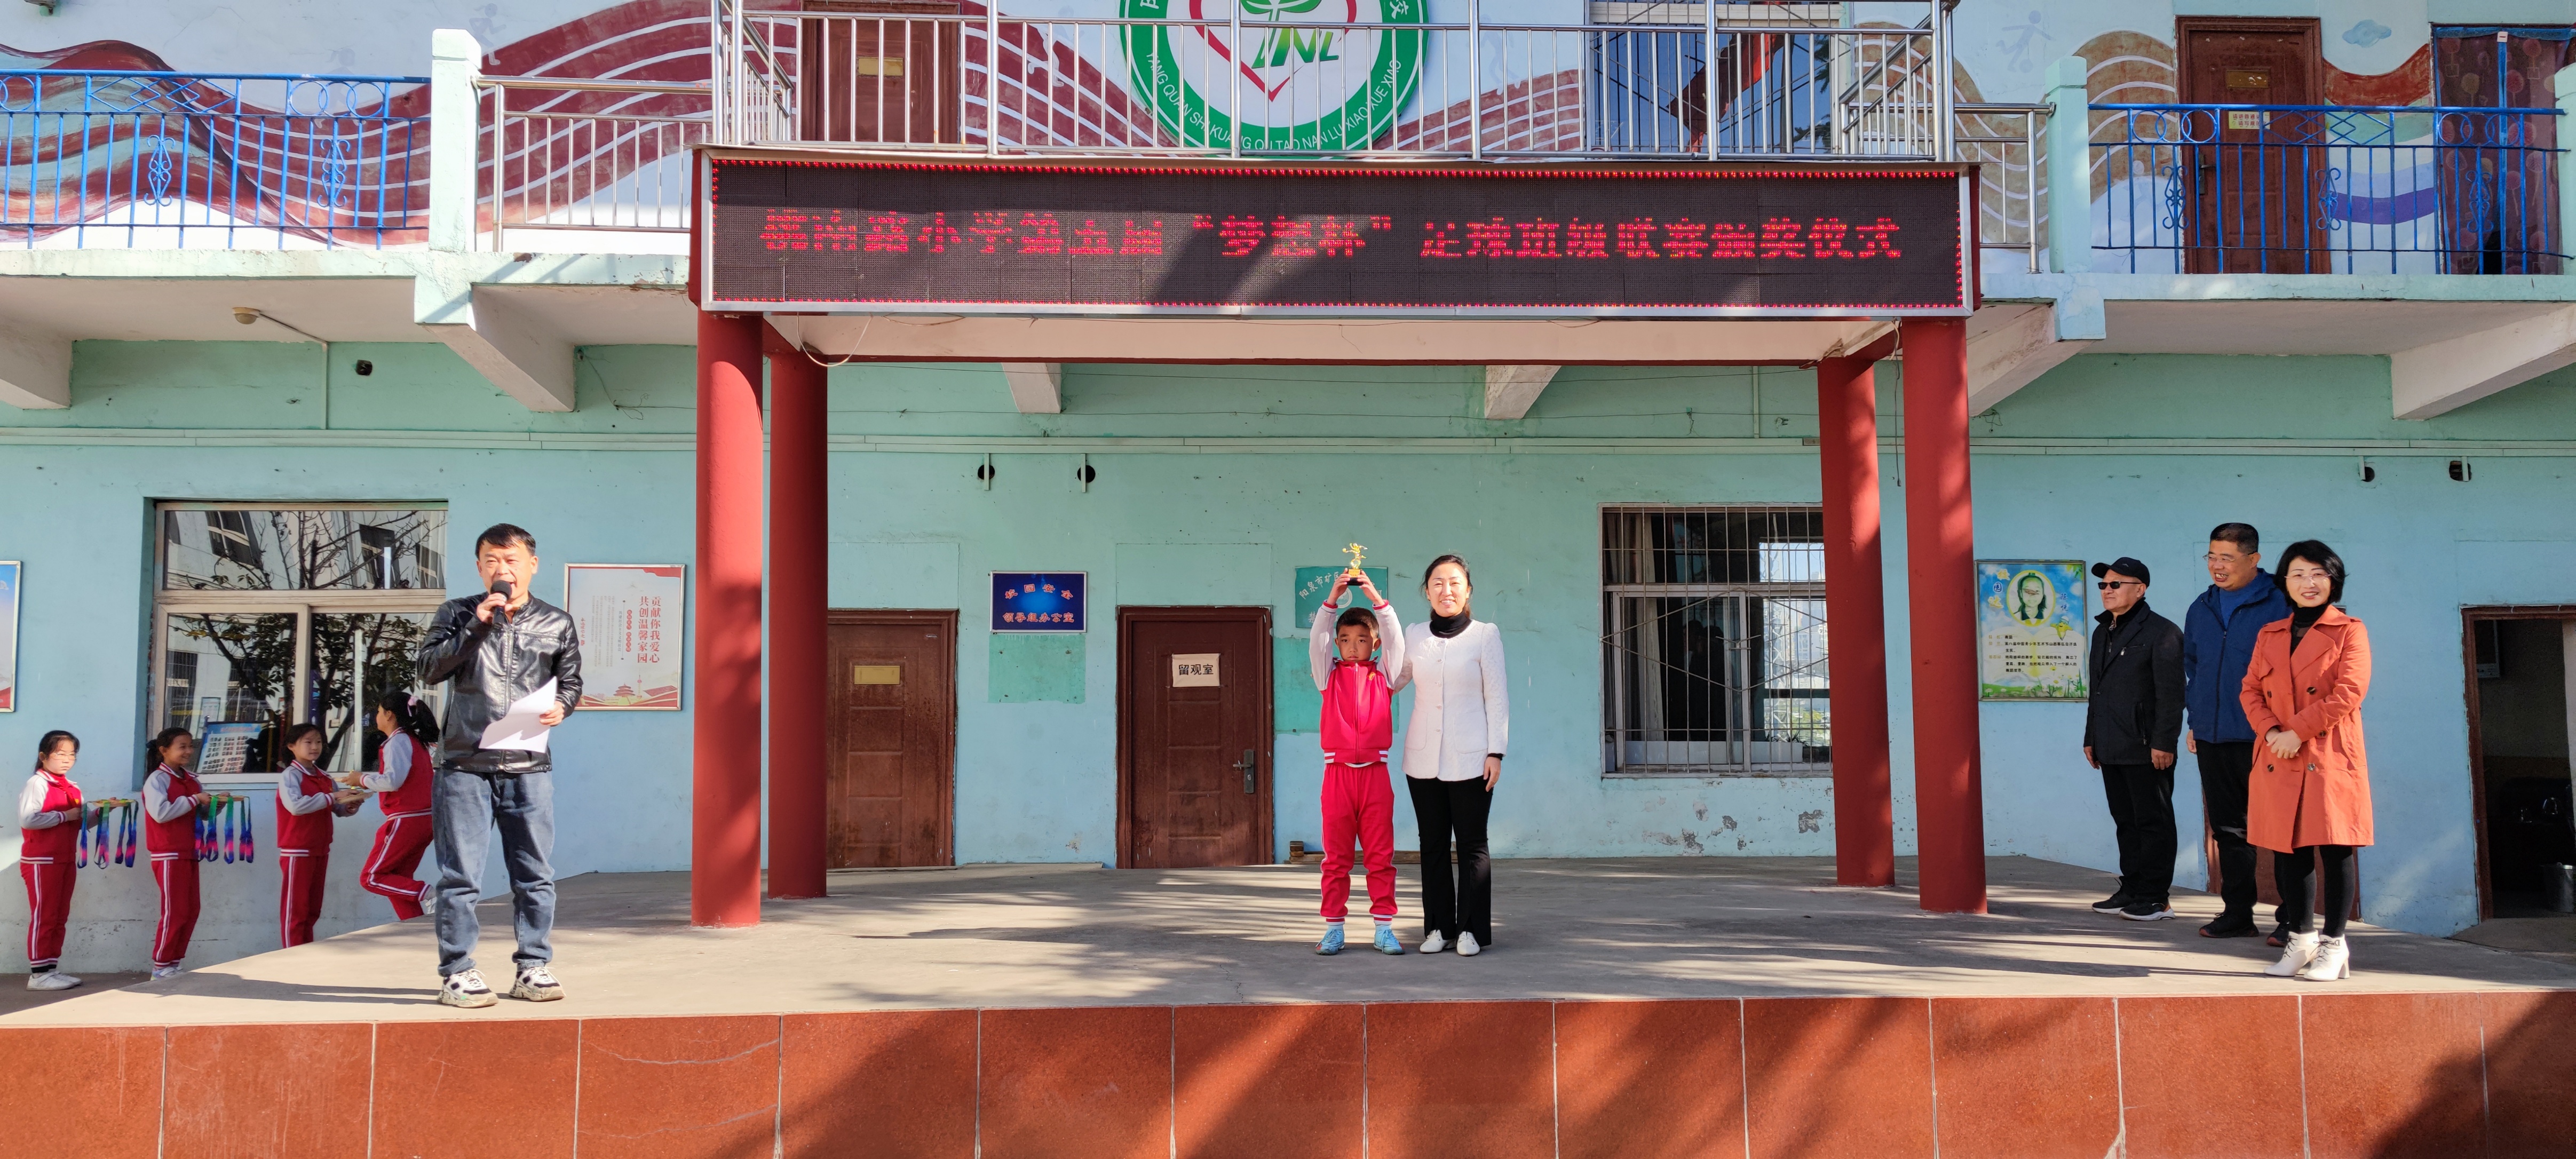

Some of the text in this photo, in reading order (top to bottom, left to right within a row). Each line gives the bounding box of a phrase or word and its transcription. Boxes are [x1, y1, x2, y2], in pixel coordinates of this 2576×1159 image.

[1190, 112, 1210, 130] SH
[1210, 125, 1251, 149] KUG
[1328, 124, 1344, 140] LU
[1345, 107, 1369, 131] XIAO
[637, 596, 649, 663] 共创温馨家园
[649, 596, 662, 663] 贡献你我爱心
[1003, 612, 1074, 623] 领导组办公室
[1178, 664, 1214, 676] 留观室
